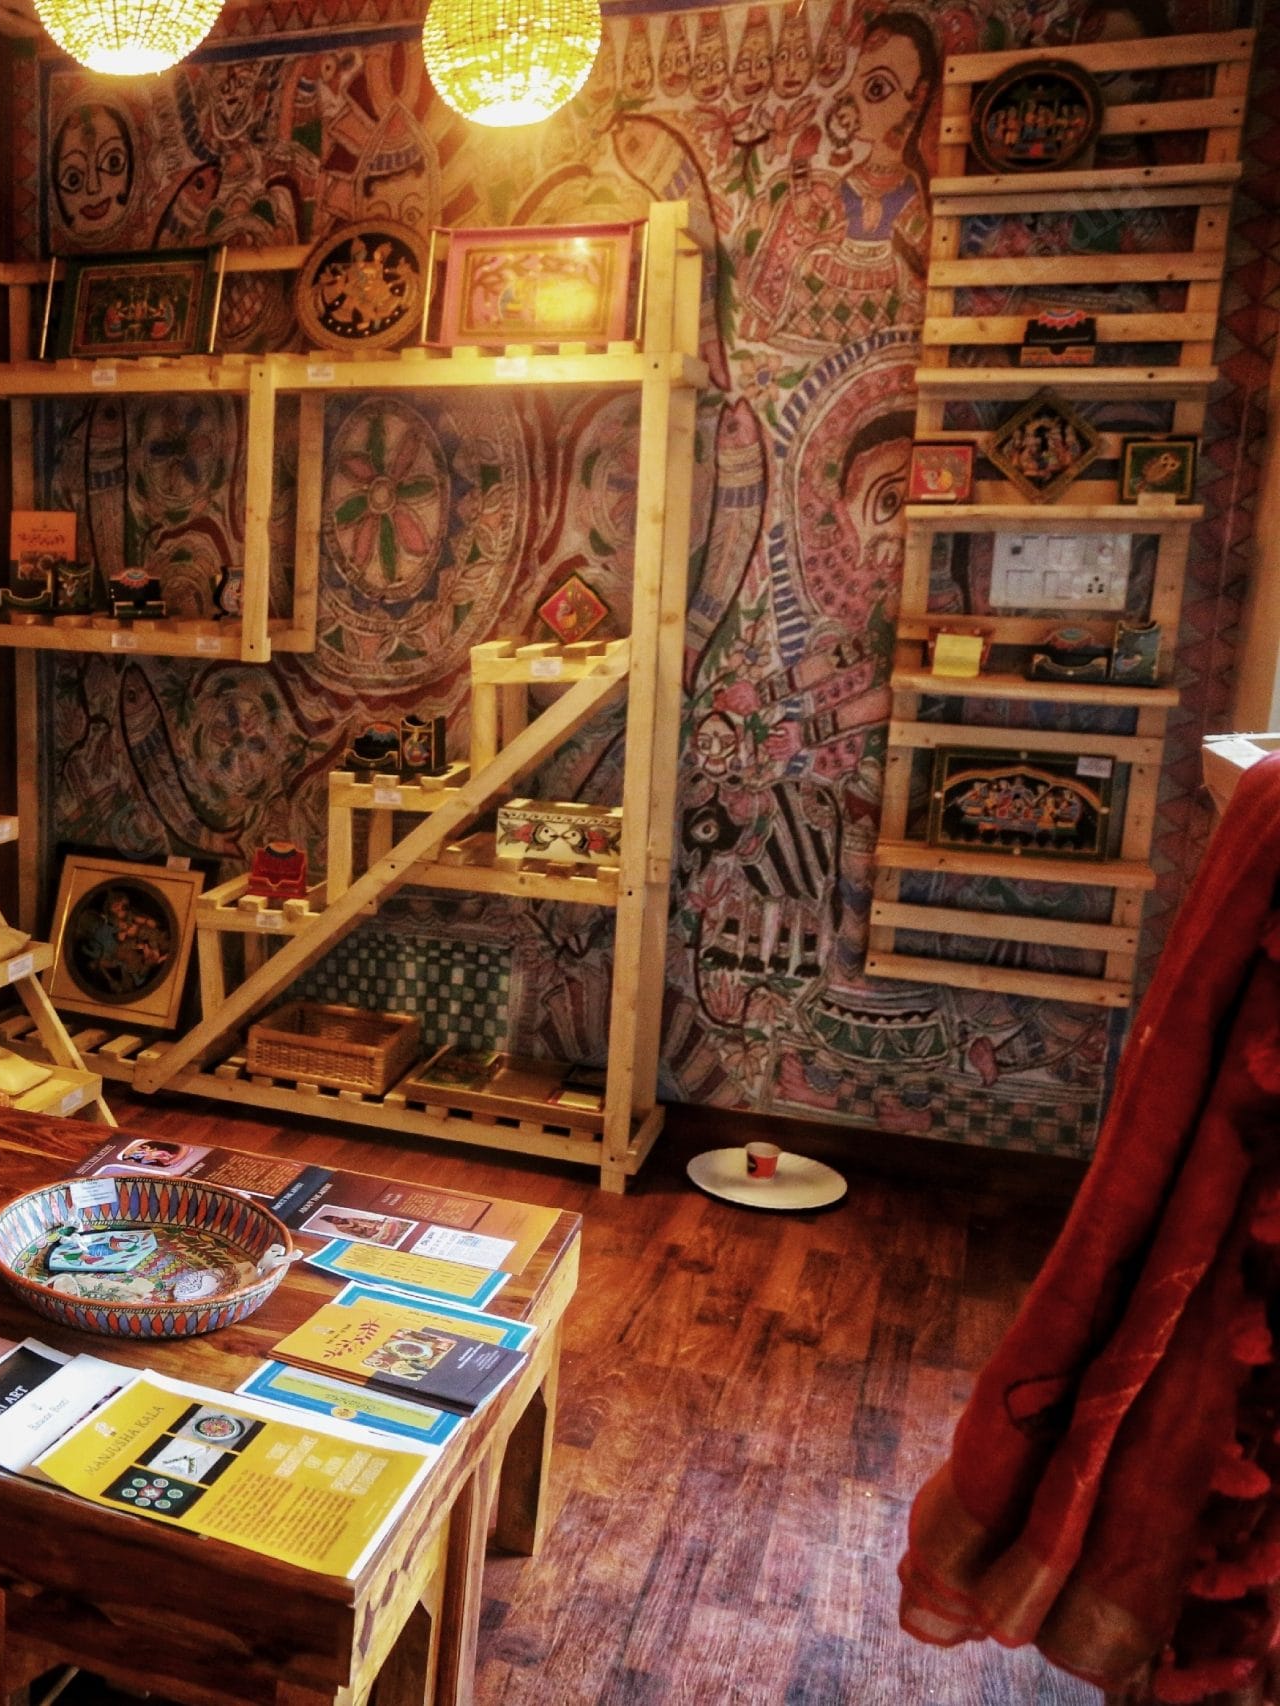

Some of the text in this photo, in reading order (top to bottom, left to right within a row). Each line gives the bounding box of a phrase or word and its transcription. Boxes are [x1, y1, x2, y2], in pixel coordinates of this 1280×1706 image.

[4, 1385, 29, 1405] ART
[84, 1405, 166, 1477] MANJUSHA KALA
